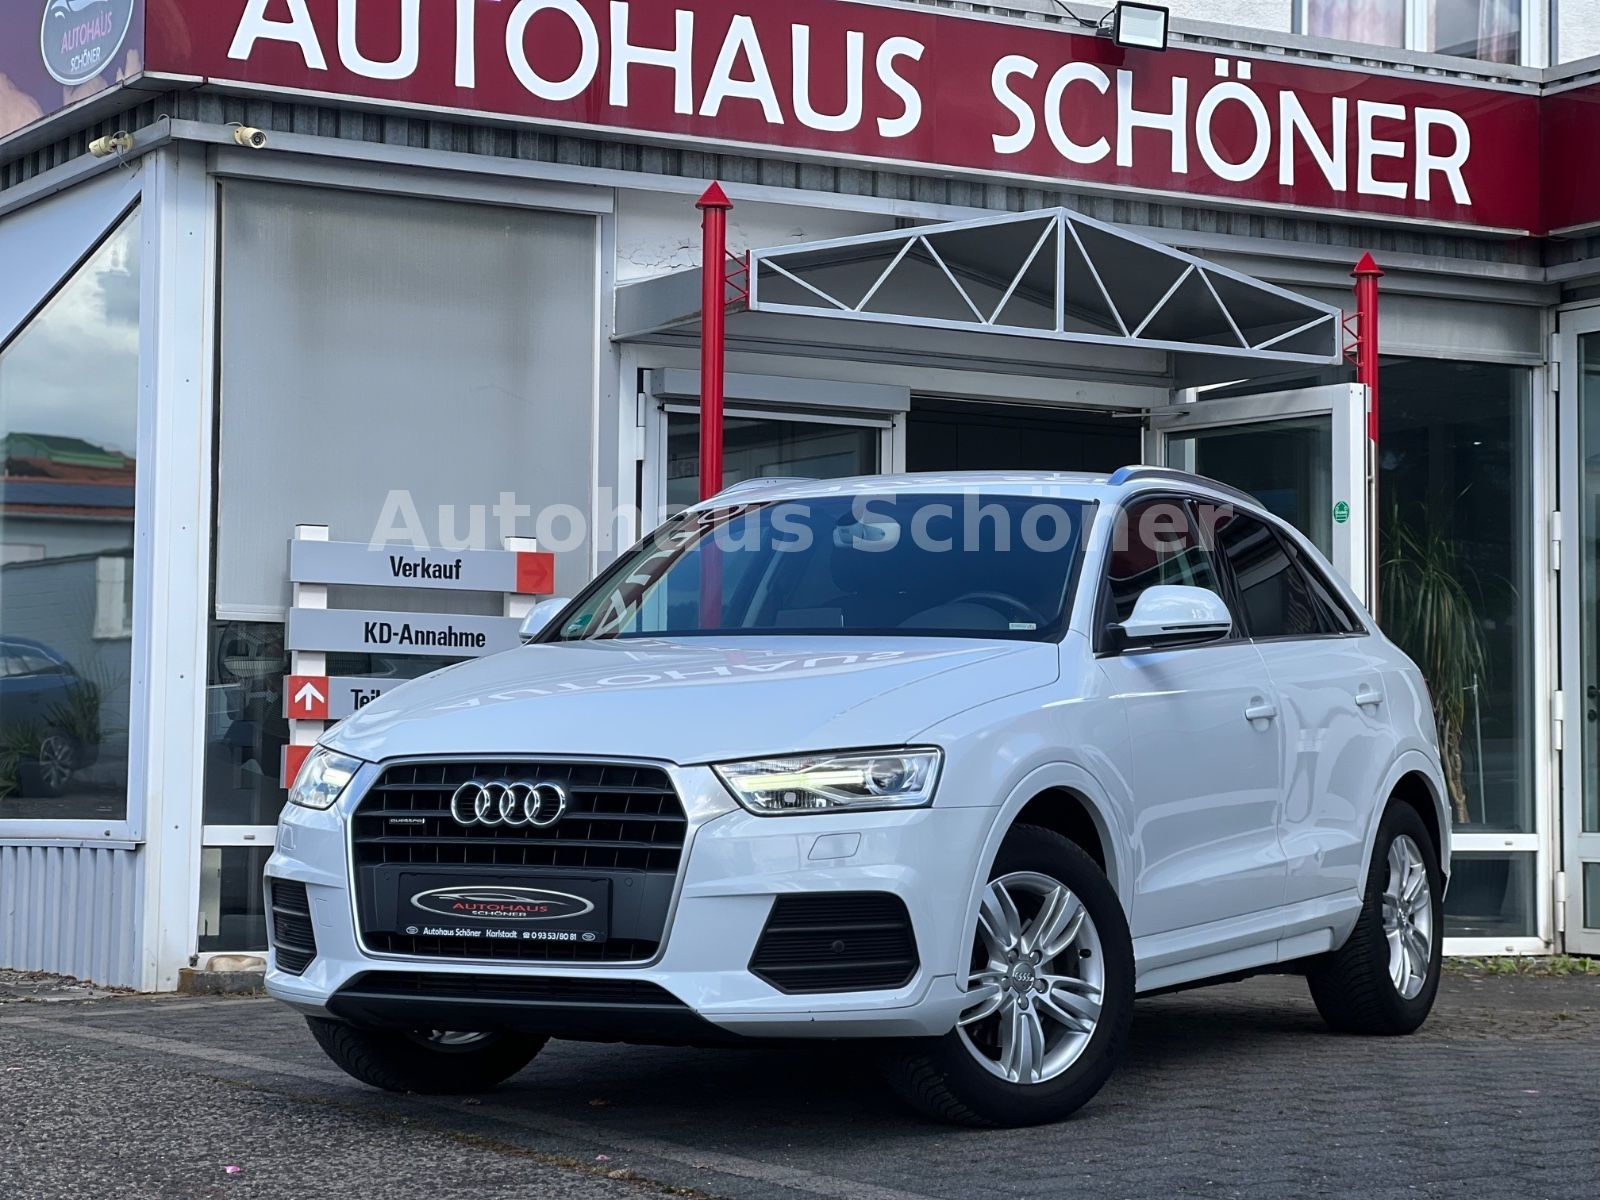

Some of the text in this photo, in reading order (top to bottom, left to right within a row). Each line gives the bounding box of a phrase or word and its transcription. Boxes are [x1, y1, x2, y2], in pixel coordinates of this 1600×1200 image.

[60, 10, 113, 54] AUTOHAUS
[70, 46, 101, 73] SCHÖNER
[226, 0, 1472, 206] AUTOHAUS SCHÖNER
[389, 555, 462, 581] Verkauf
[364, 621, 486, 648] KD-Annahme
[452, 902, 549, 913] AUTOHAUS
[423, 927, 454, 936] Autohaus
[455, 928, 481, 937] Schöner
[486, 929, 518, 938] Karlstadt
